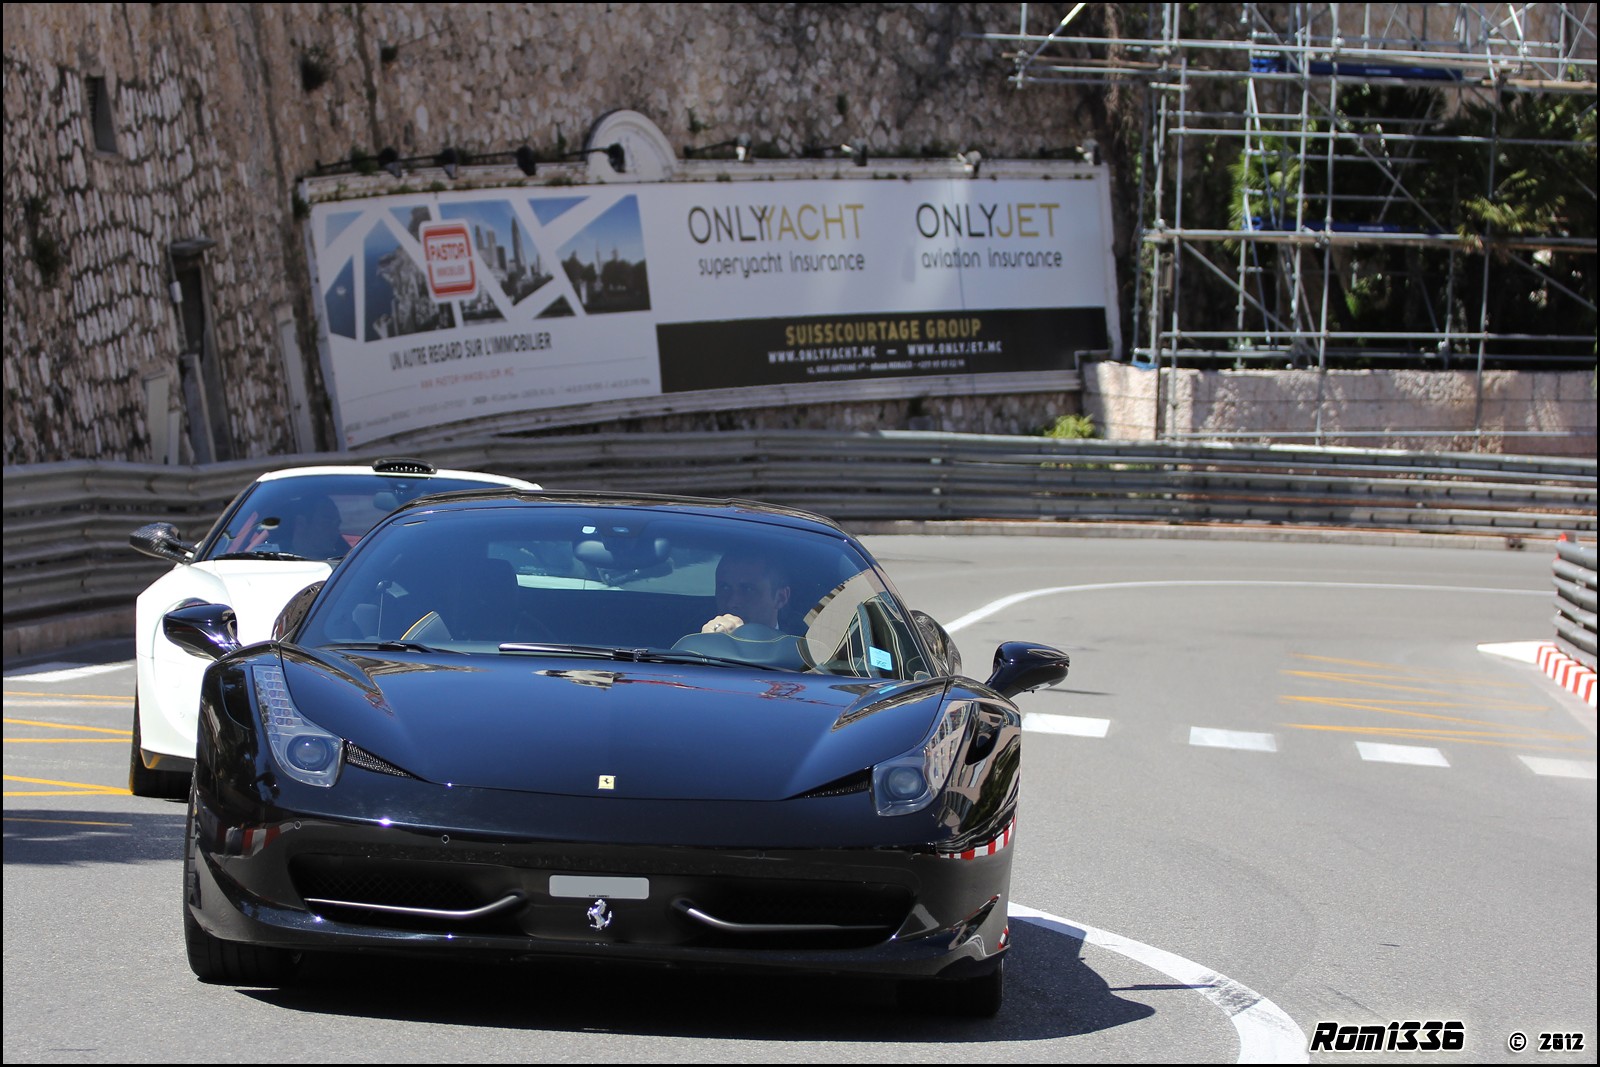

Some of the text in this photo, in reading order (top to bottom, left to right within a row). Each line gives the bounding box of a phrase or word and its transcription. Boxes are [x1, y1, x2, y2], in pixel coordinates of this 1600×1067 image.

[688, 203, 864, 244] ONLYYACHT
[916, 203, 1060, 239] ONLYJET
[429, 242, 466, 261] PASTOR
[699, 250, 866, 279] superyacht insurance
[922, 247, 1063, 270] aviation insurance
[785, 318, 982, 346] SUISSCOURTAGE GROUP
[390, 331, 553, 371] UN AUTRE REGARD SUR L'IMMOBILIER
[768, 346, 877, 364] WWW.ONLYYACHT.MC
